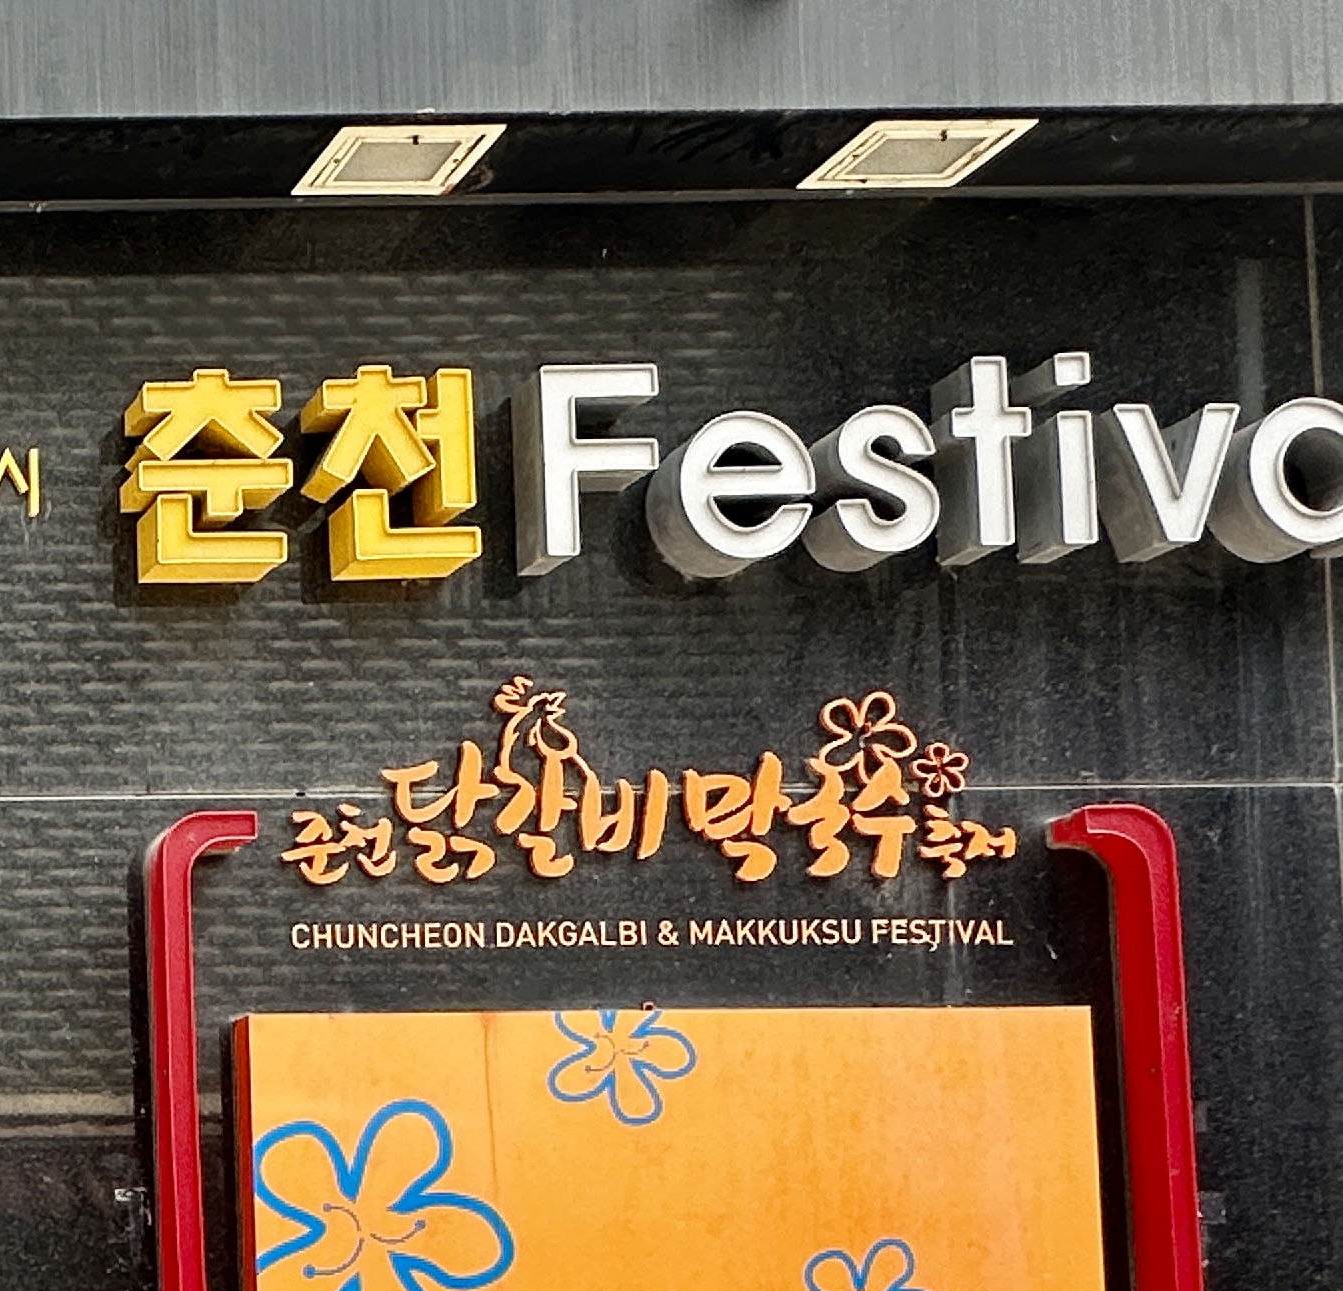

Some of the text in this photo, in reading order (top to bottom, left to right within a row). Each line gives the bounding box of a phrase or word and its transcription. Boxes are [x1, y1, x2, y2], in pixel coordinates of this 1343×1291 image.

[120, 364, 482, 586] 춘천
[291, 922, 485, 949] CHUNCHEON
[496, 920, 647, 947] DAKGALBI
[658, 920, 679, 946] &
[689, 919, 862, 946] MAKKUKSU
